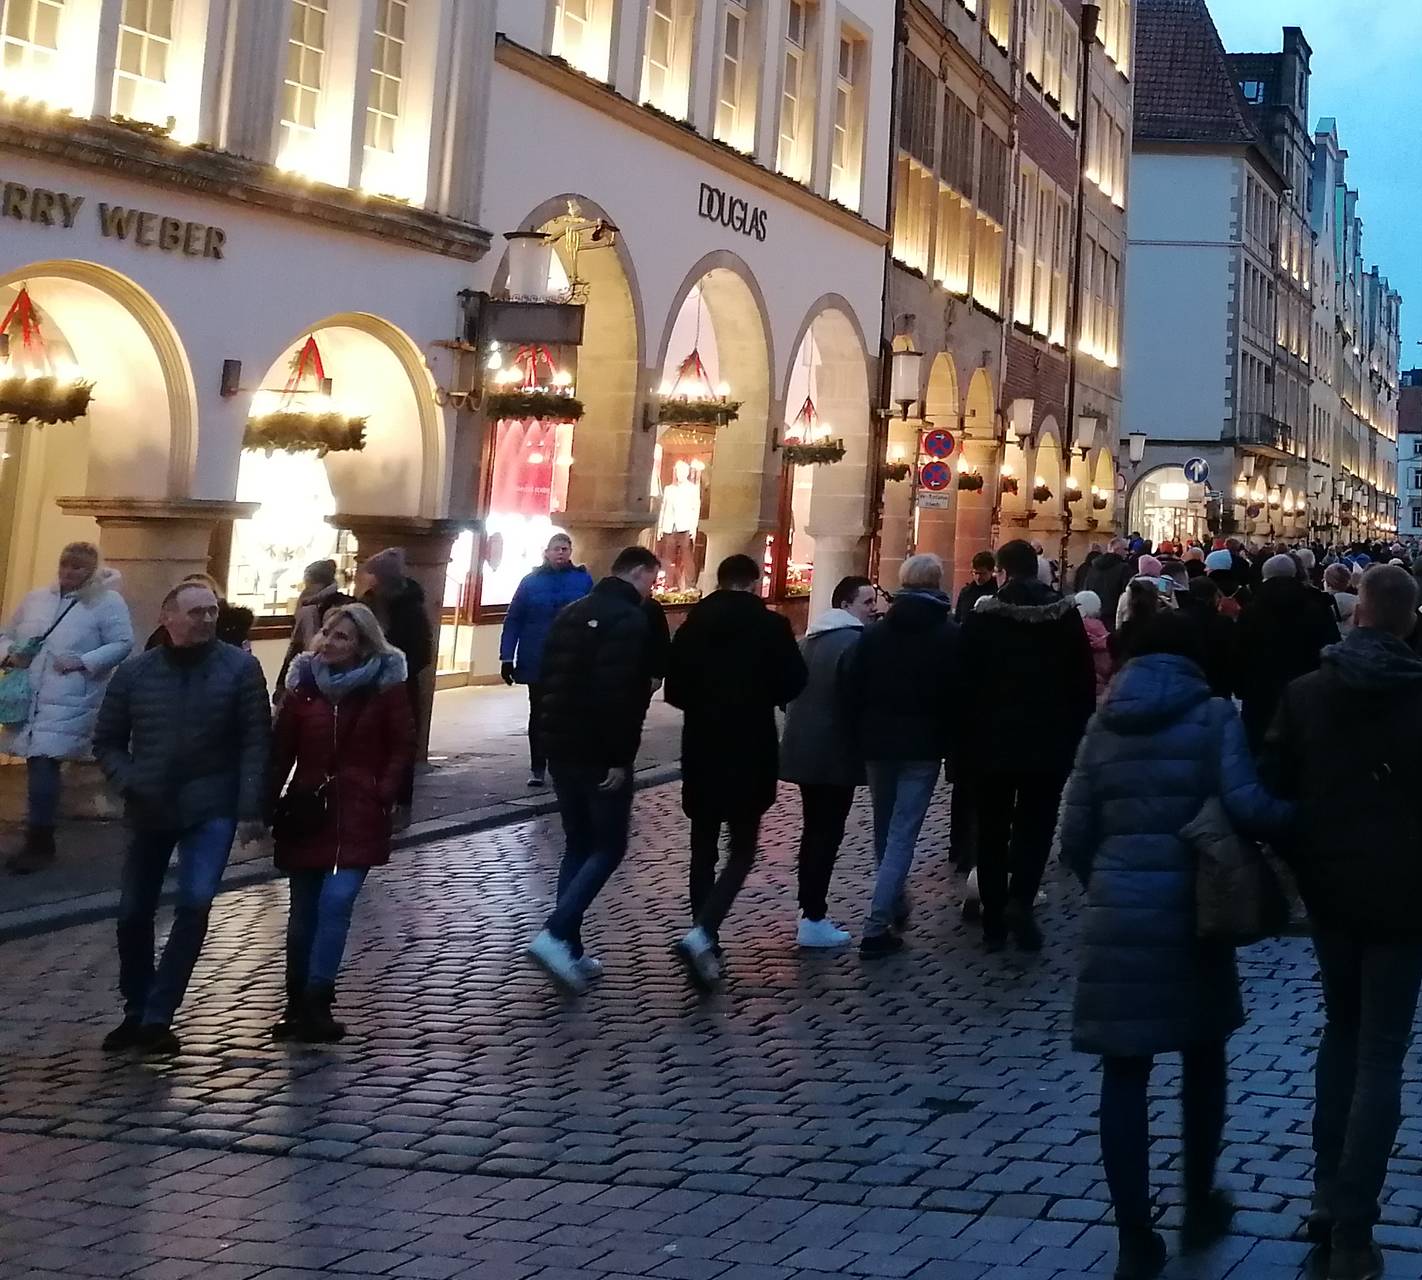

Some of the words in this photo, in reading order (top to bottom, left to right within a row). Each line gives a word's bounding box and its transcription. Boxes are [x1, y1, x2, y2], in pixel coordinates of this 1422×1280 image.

[0, 181, 85, 228] RRY
[98, 203, 227, 259] WEBER
[699, 182, 767, 242] DOUGLAS
